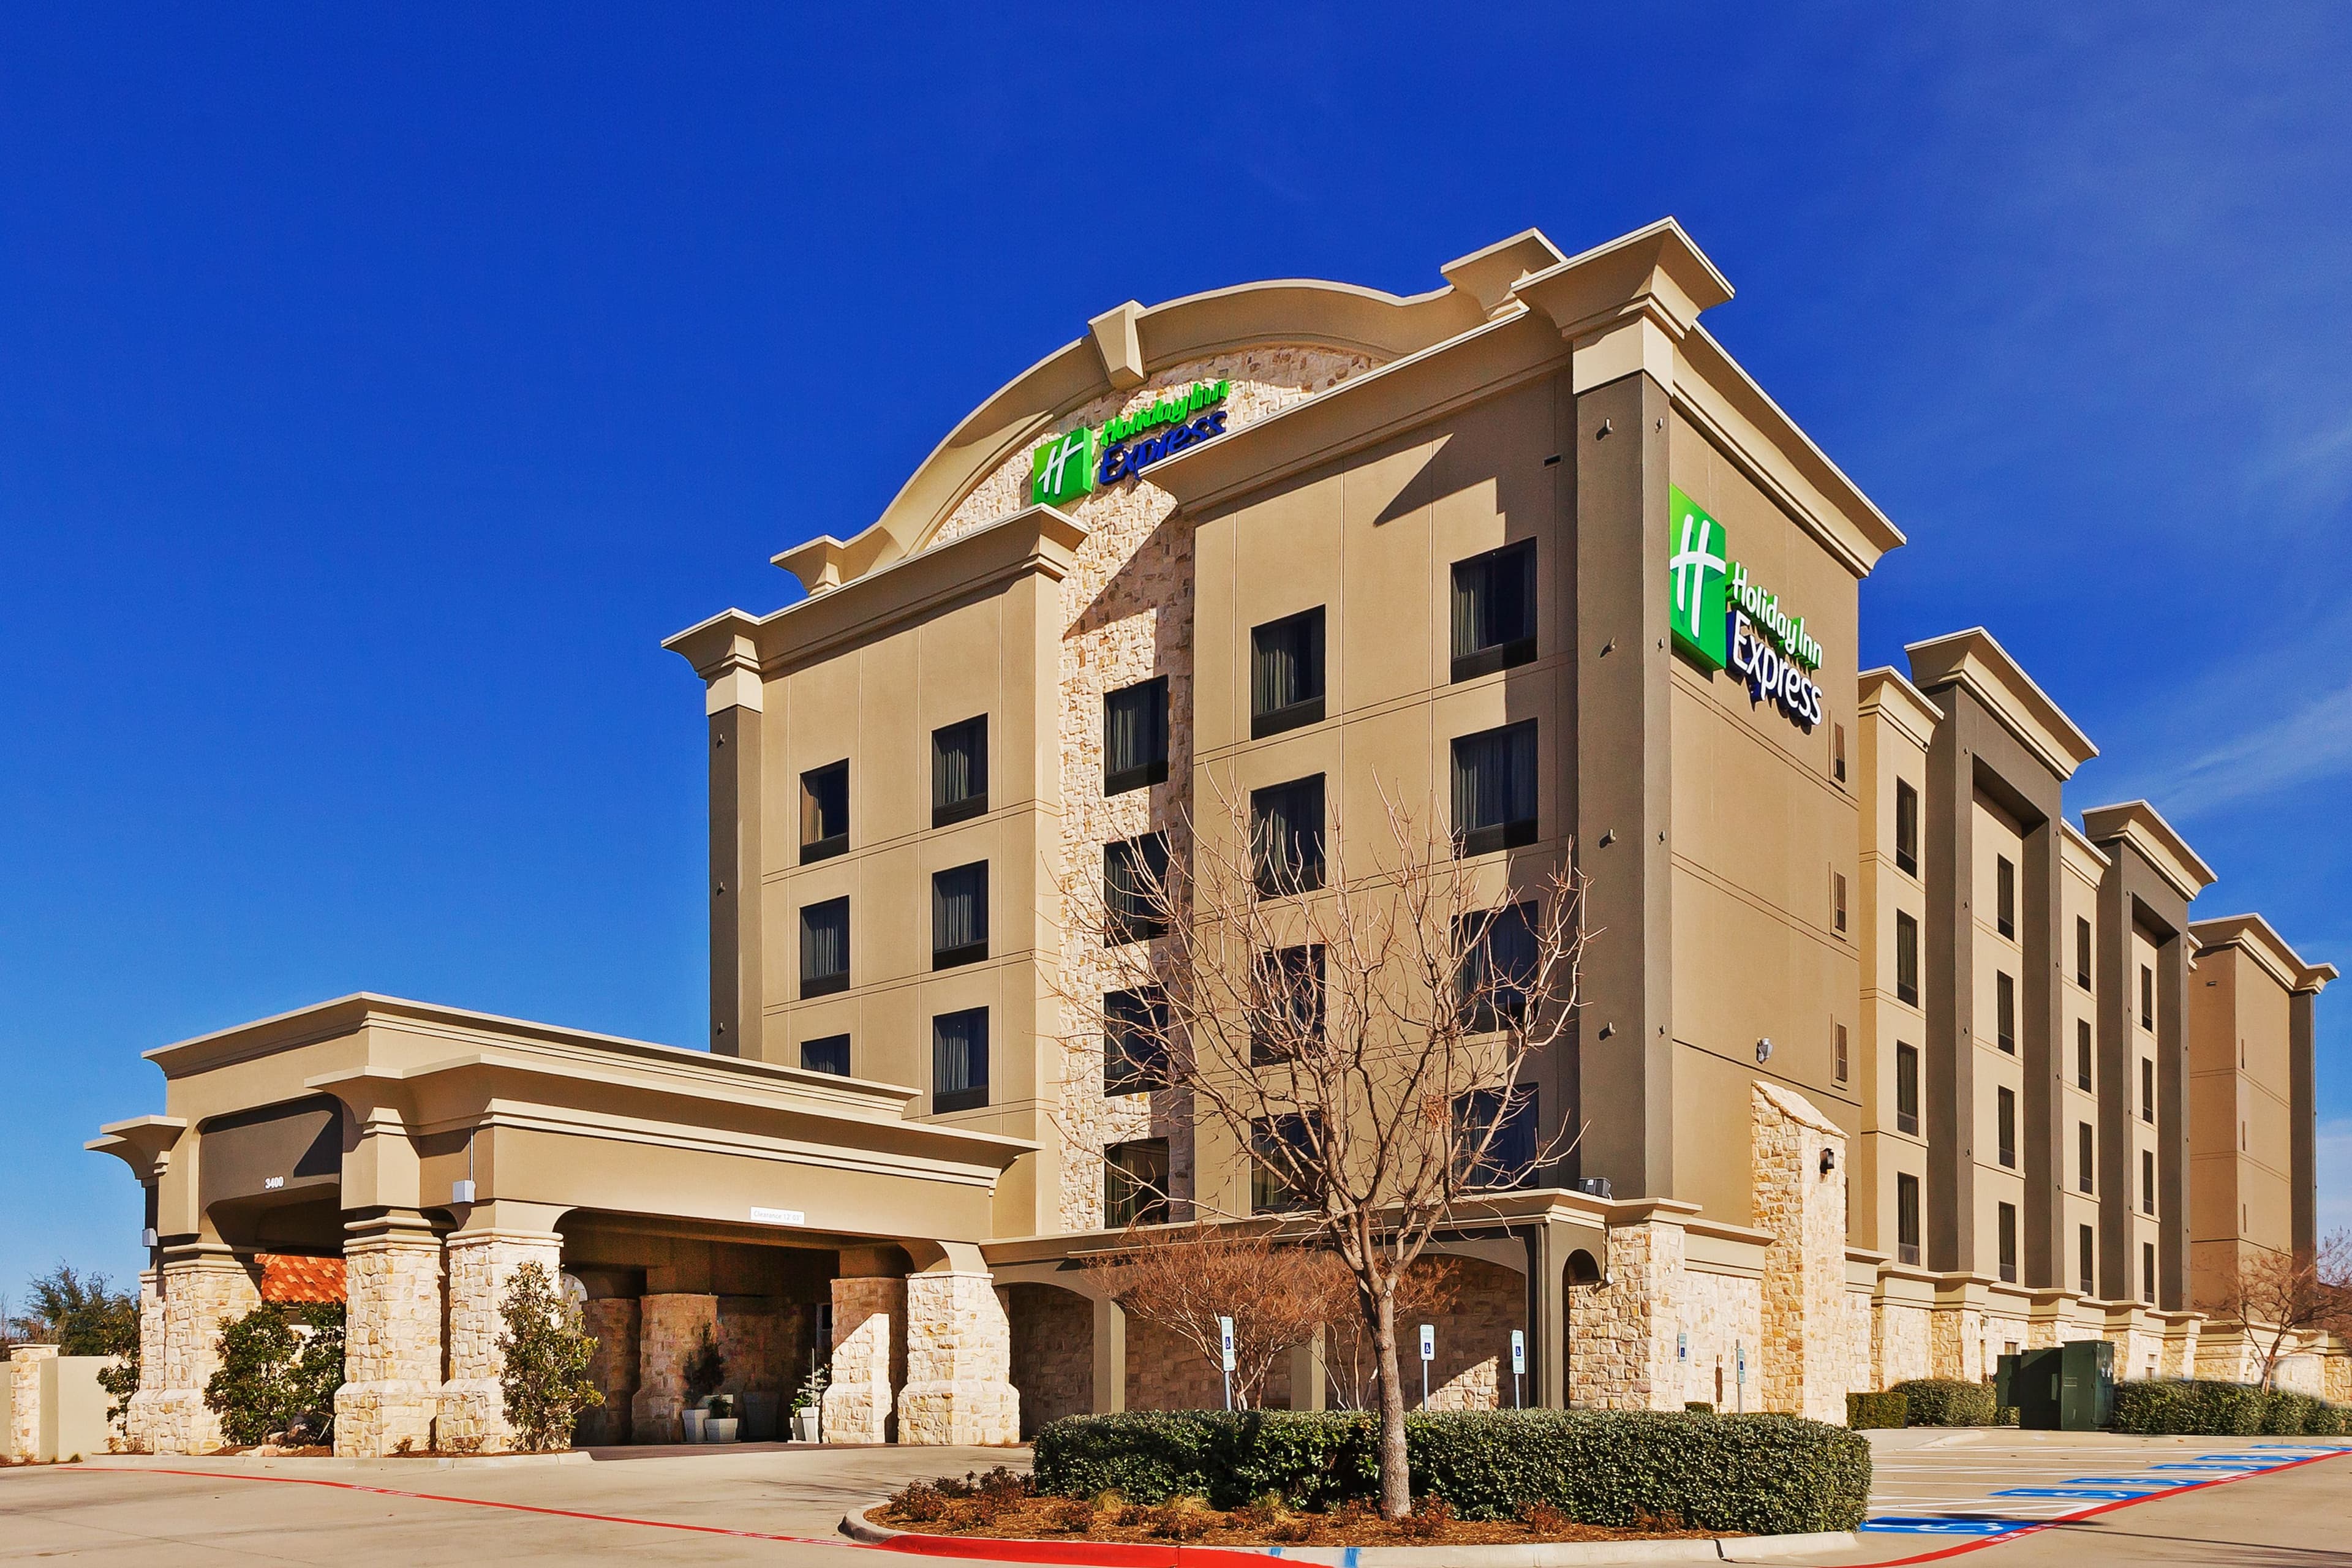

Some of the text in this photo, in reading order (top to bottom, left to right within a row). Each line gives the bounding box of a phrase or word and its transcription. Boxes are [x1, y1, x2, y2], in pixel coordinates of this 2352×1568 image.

[1099, 410, 1227, 486] Express
[1100, 379, 1230, 447] Holiday Inn
[1732, 560, 1823, 669] Holiday Inn
[1732, 609, 1823, 726] Express
[265, 1176, 284, 1189] 3400
